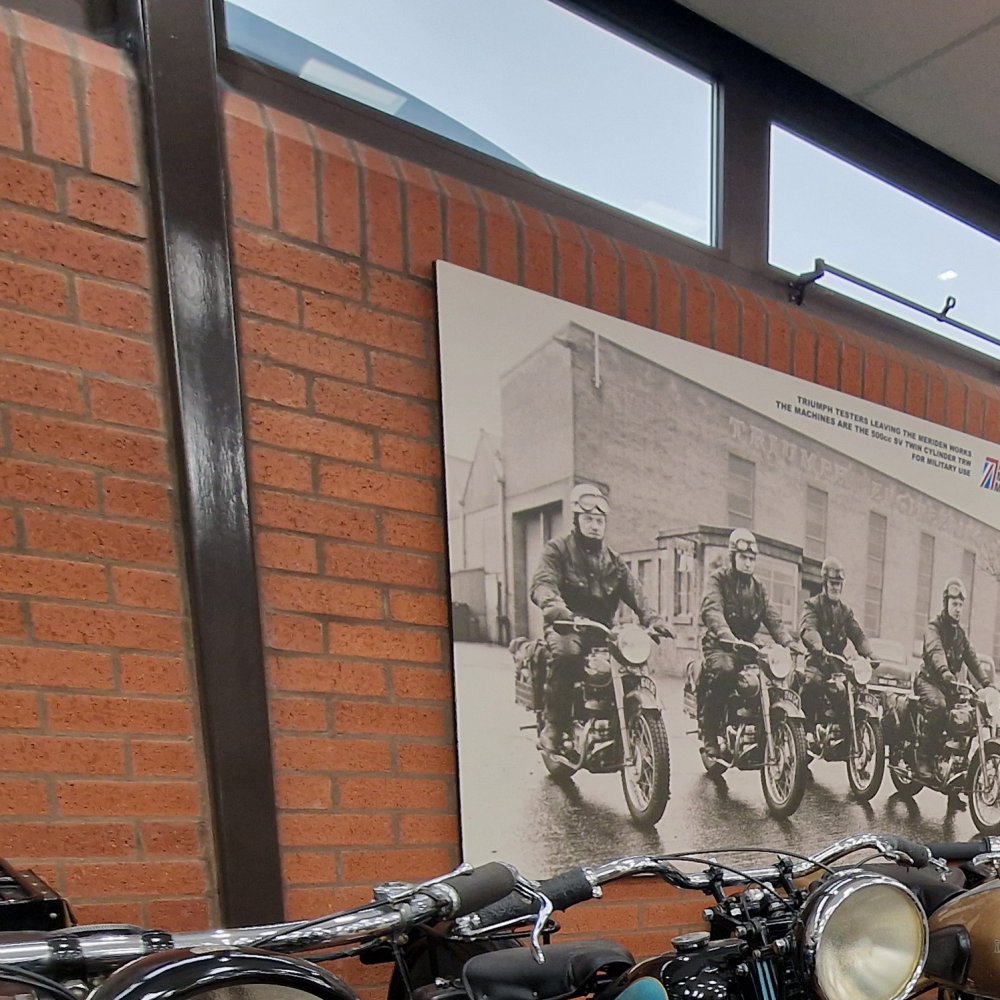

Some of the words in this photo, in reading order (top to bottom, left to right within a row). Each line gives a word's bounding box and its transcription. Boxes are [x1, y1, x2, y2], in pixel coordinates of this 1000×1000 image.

[776, 400, 792, 412] THE
[794, 406, 835, 426] MACHINES
[838, 420, 852, 431] ARE
[855, 425, 869, 436] THE
[871, 431, 892, 443] 500cc
[894, 438, 903, 446] SV
[905, 441, 922, 452] TWIN
[924, 447, 956, 463] CYLINDER
[958, 457, 971, 467] TRW
[797, 396, 833, 414] TRIUMPH
[836, 408, 868, 425] TESTERS
[870, 419, 900, 435] LEAVING
[903, 430, 916, 440] THE
[919, 435, 948, 450] MERIDEN
[949, 445, 972, 457] WORKS
[912, 453, 925, 463] FOR
[927, 457, 956, 473] MILITARY
[958, 467, 970, 477] USE
